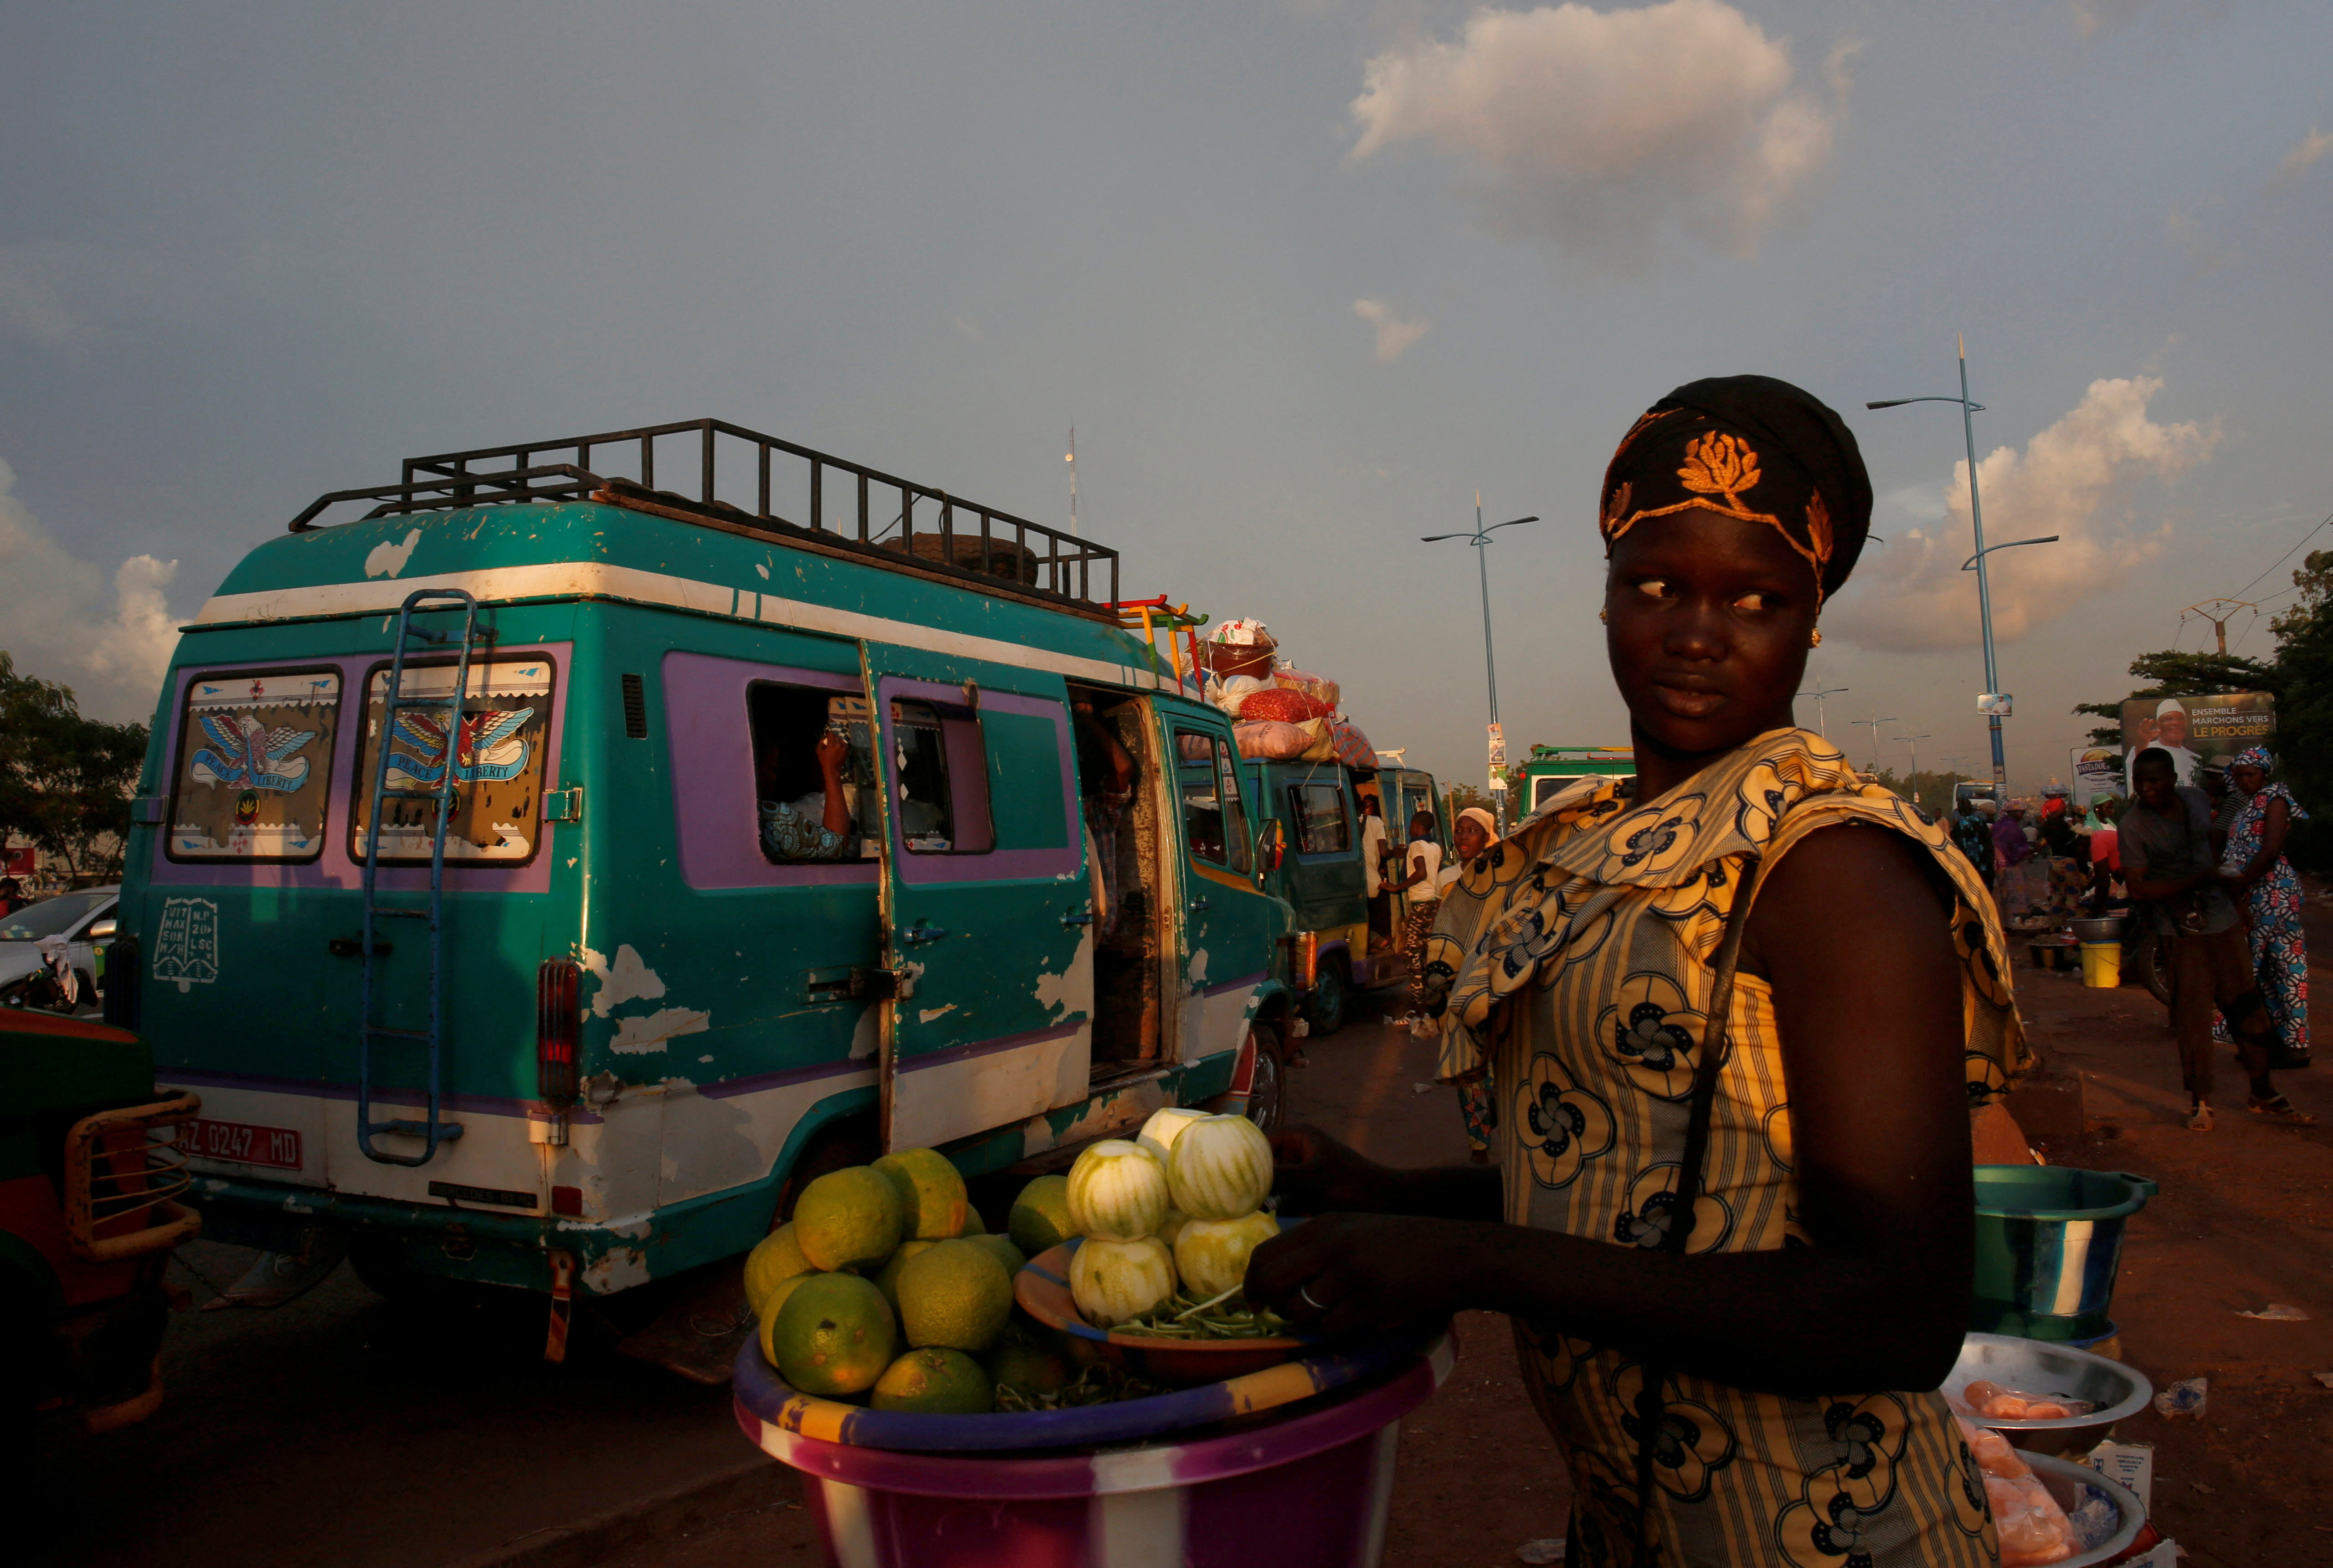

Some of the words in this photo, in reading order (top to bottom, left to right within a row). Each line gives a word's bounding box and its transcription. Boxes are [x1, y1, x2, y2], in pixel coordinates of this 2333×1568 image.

[2192, 707, 2237, 716] ENSEMBLE
[2193, 716, 2244, 725] MARCHONS
[2194, 727, 2209, 737] LE
[2211, 723, 2269, 736] PROGRÈS
[205, 753, 232, 779] PEACE
[257, 776, 293, 790] LIBERTY
[399, 756, 433, 780] PEACE
[465, 766, 509, 779] LIBERTY
[164, 919, 185, 929] MAX
[208, 1124, 253, 1157] 0247
[270, 1131, 296, 1163] MD
